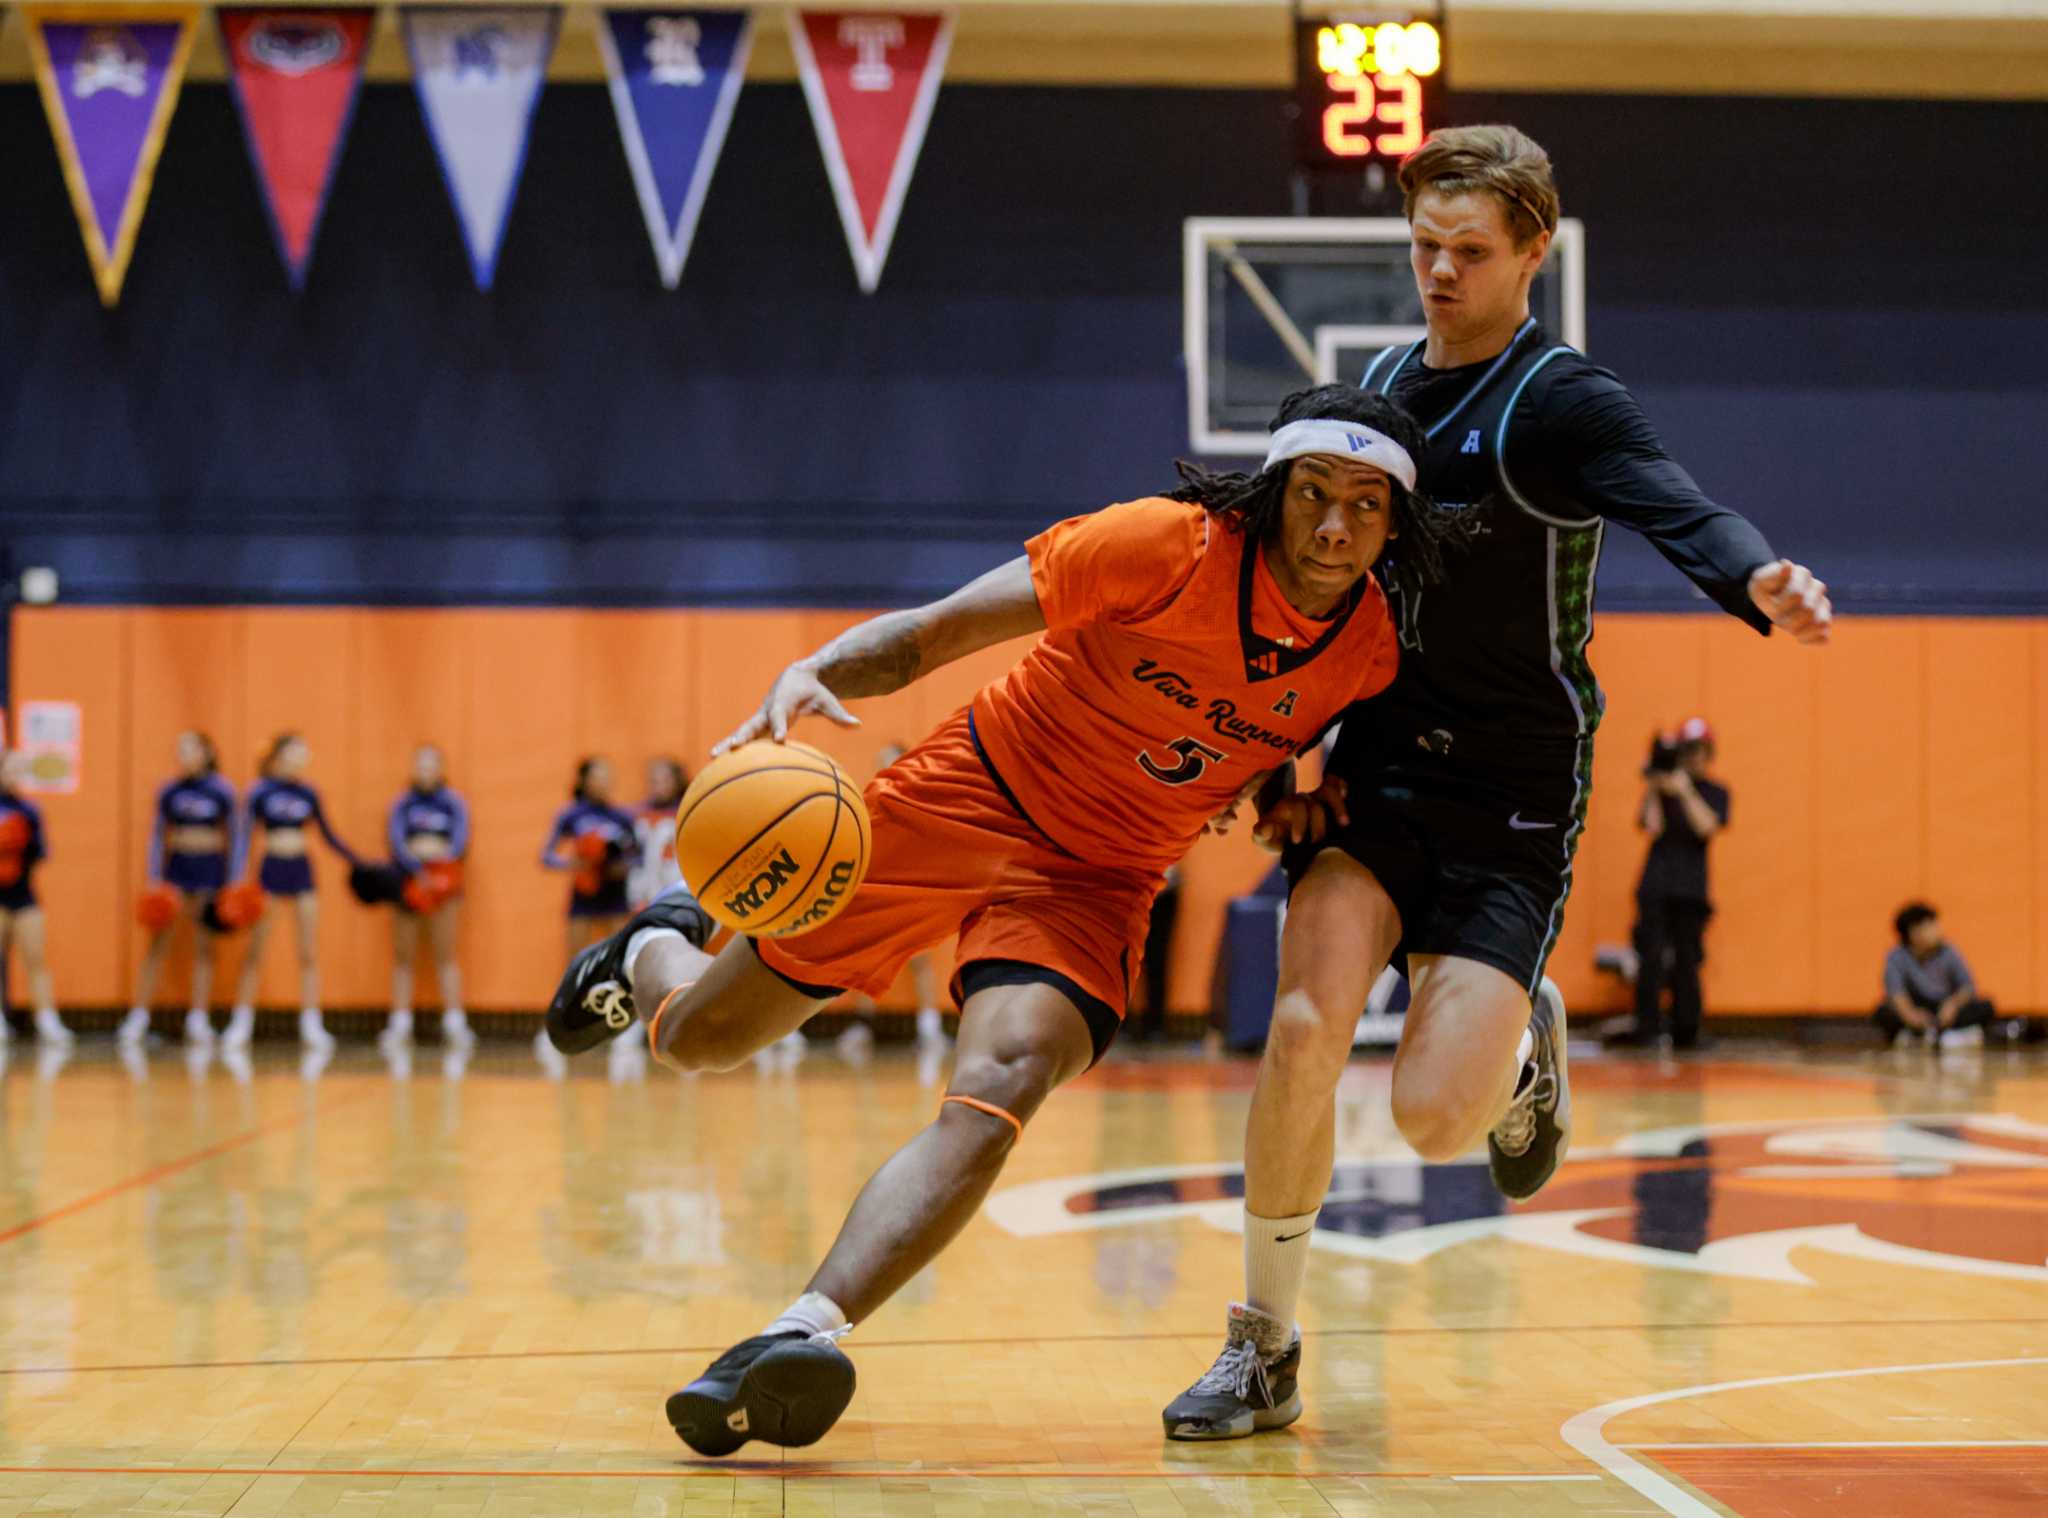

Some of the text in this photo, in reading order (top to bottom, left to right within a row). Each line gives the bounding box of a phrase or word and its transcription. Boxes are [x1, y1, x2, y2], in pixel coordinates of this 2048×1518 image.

[1322, 71, 1424, 156] 23
[1460, 429, 1481, 454] A
[1271, 688, 1300, 718] A
[1135, 735, 1230, 786] 5
[723, 847, 800, 919] NCAA
